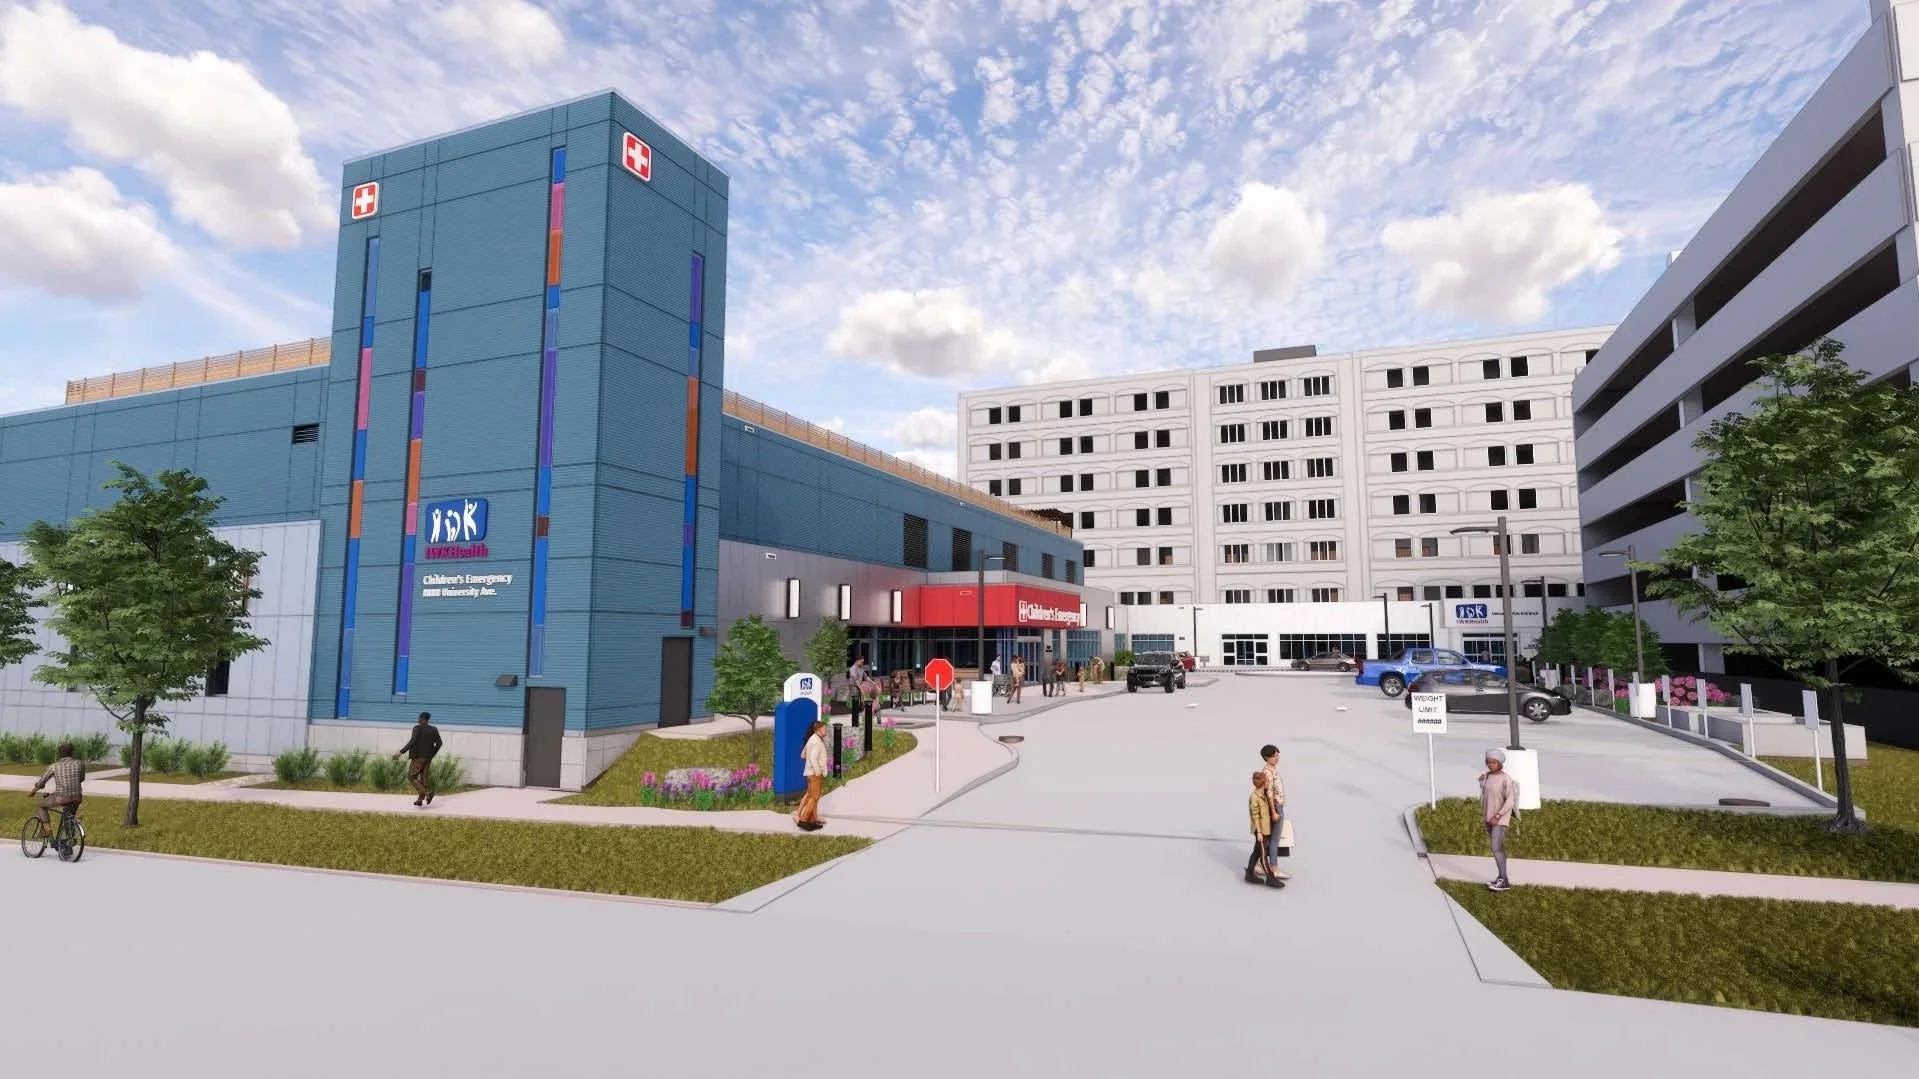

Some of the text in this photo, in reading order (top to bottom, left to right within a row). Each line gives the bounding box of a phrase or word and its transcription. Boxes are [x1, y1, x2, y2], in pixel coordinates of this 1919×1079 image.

[423, 574, 512, 585] Children's Emergency
[441, 586, 480, 598] University
[480, 586, 497, 596] Ave.
[1027, 603, 1080, 627] Children's Emergency
